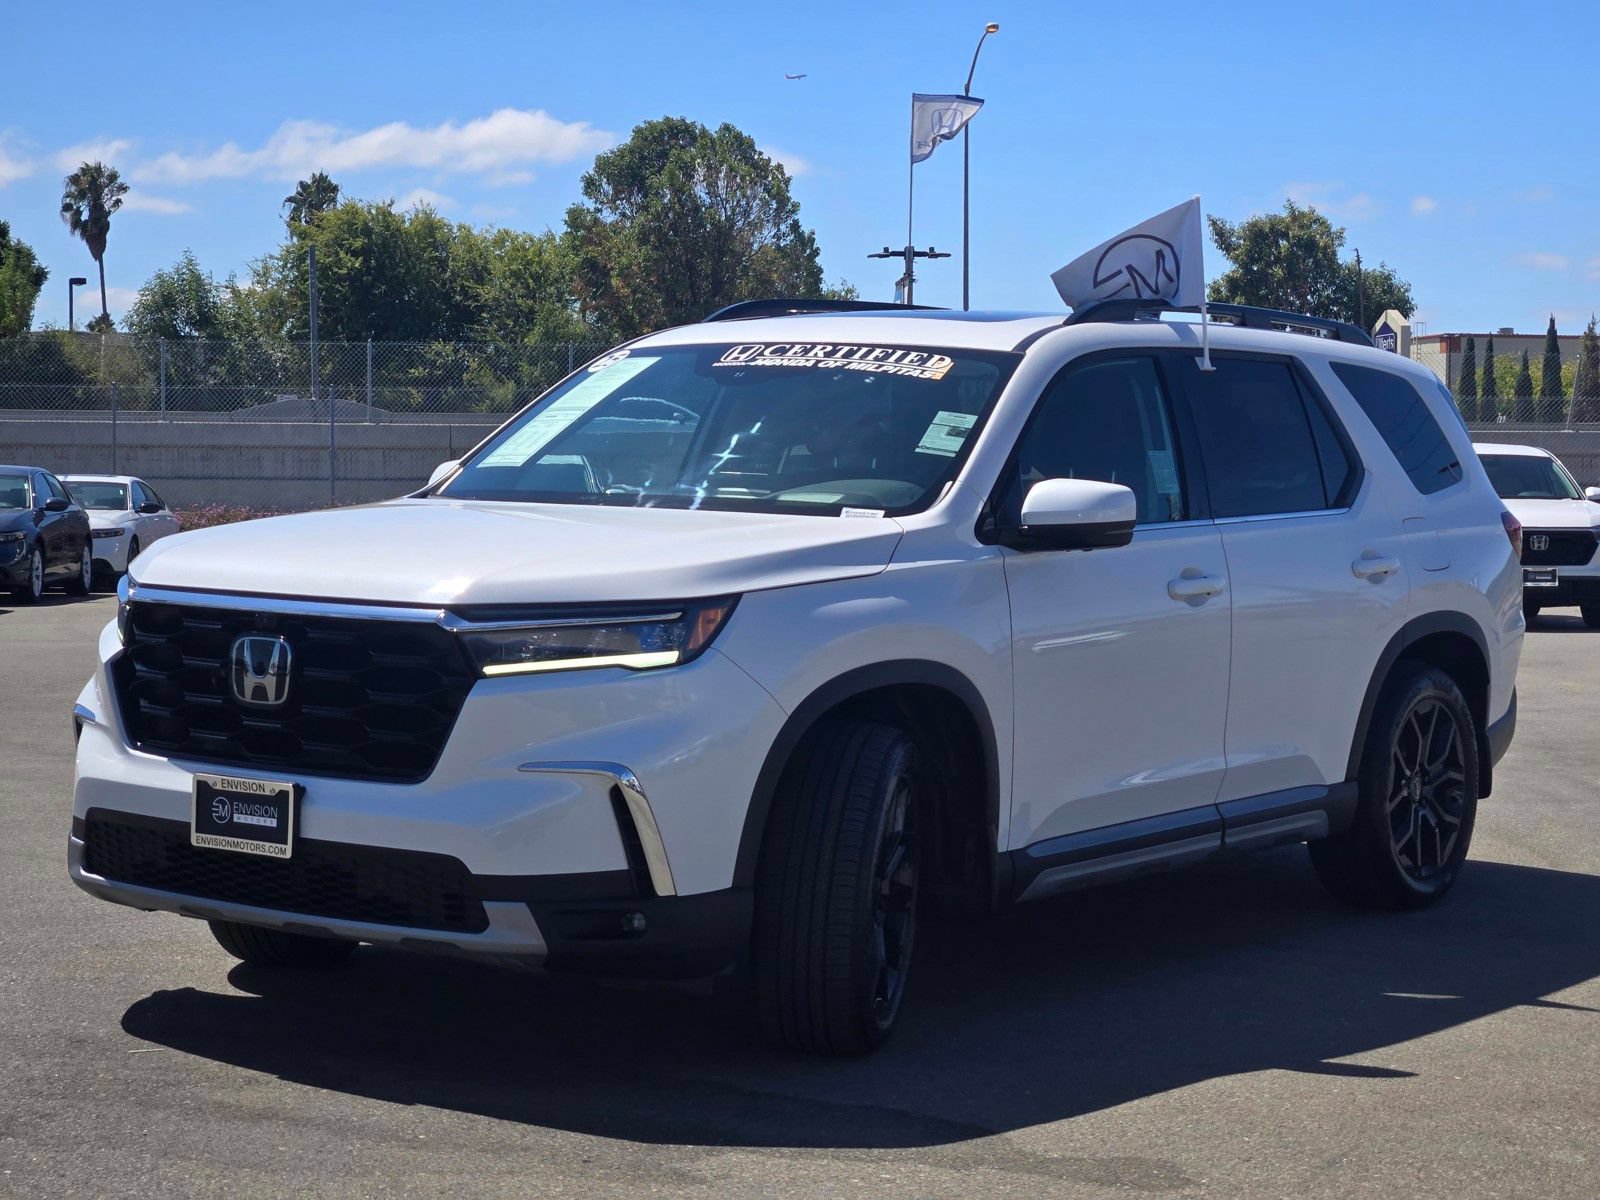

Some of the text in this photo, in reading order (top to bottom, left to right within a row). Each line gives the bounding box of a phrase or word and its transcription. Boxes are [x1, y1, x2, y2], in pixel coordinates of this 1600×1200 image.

[764, 344, 952, 369] CERTIFIED
[753, 358, 934, 379] HONDA OF MILPITAS
[221, 779, 266, 793] ENVISION
[233, 801, 278, 818] ENVISION
[236, 816, 274, 825] MOTORS
[196, 836, 287, 856] ENVISIONMOTORS.COM
